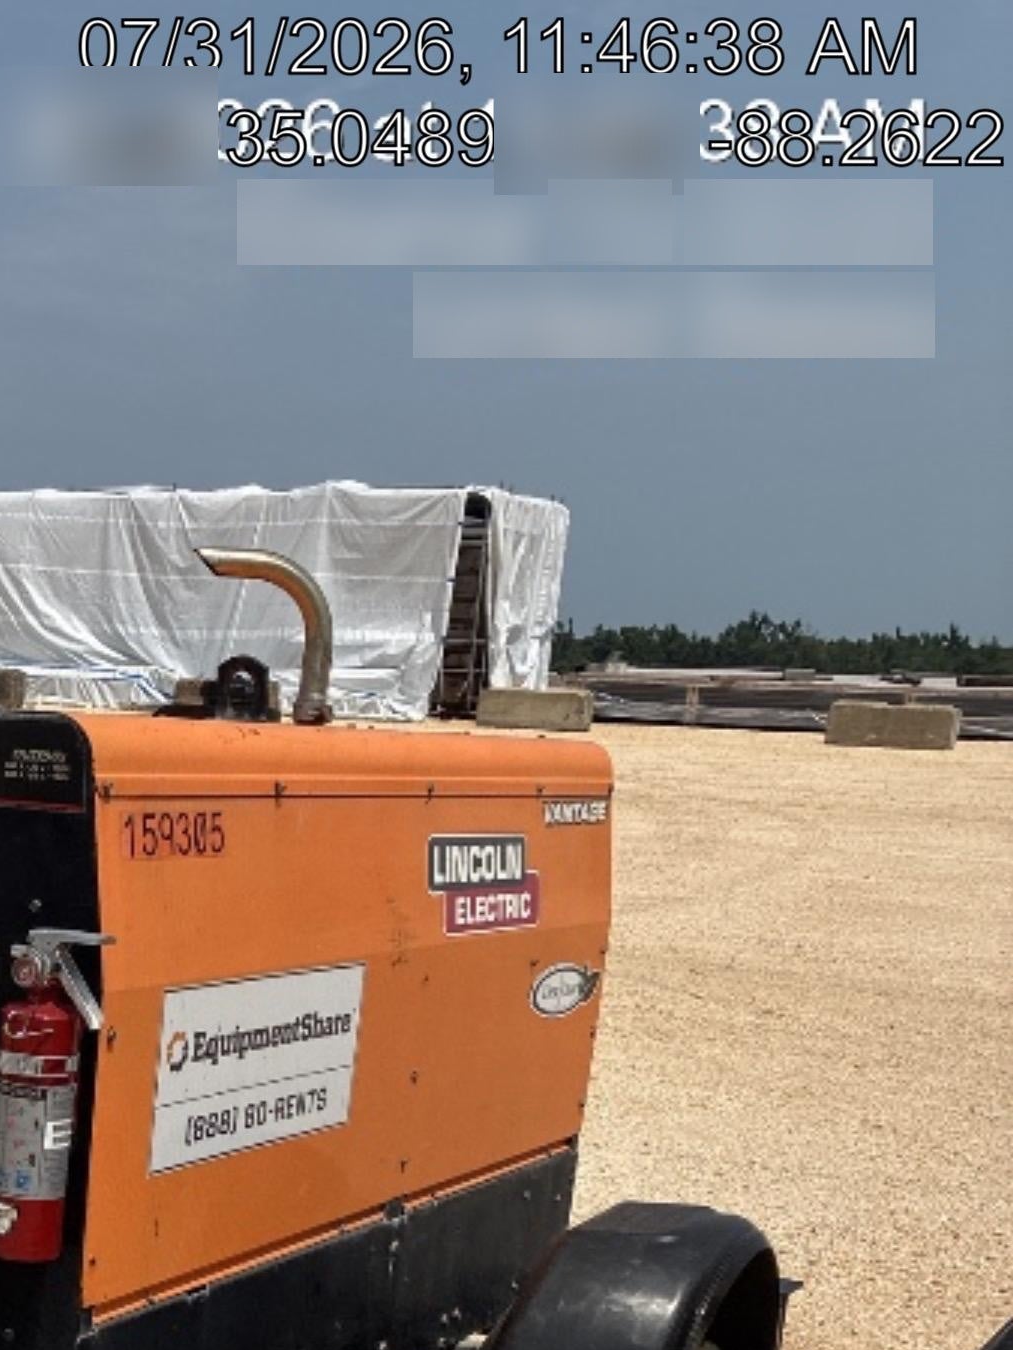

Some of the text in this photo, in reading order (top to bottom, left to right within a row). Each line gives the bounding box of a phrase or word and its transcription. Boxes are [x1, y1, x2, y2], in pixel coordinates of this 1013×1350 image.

[544, 801, 607, 824] VANTAGE
[124, 812, 225, 859] 159305
[433, 842, 523, 884] LINCOLN
[454, 892, 532, 925] ELECTRIC
[191, 1011, 352, 1065] EquipmentShare
